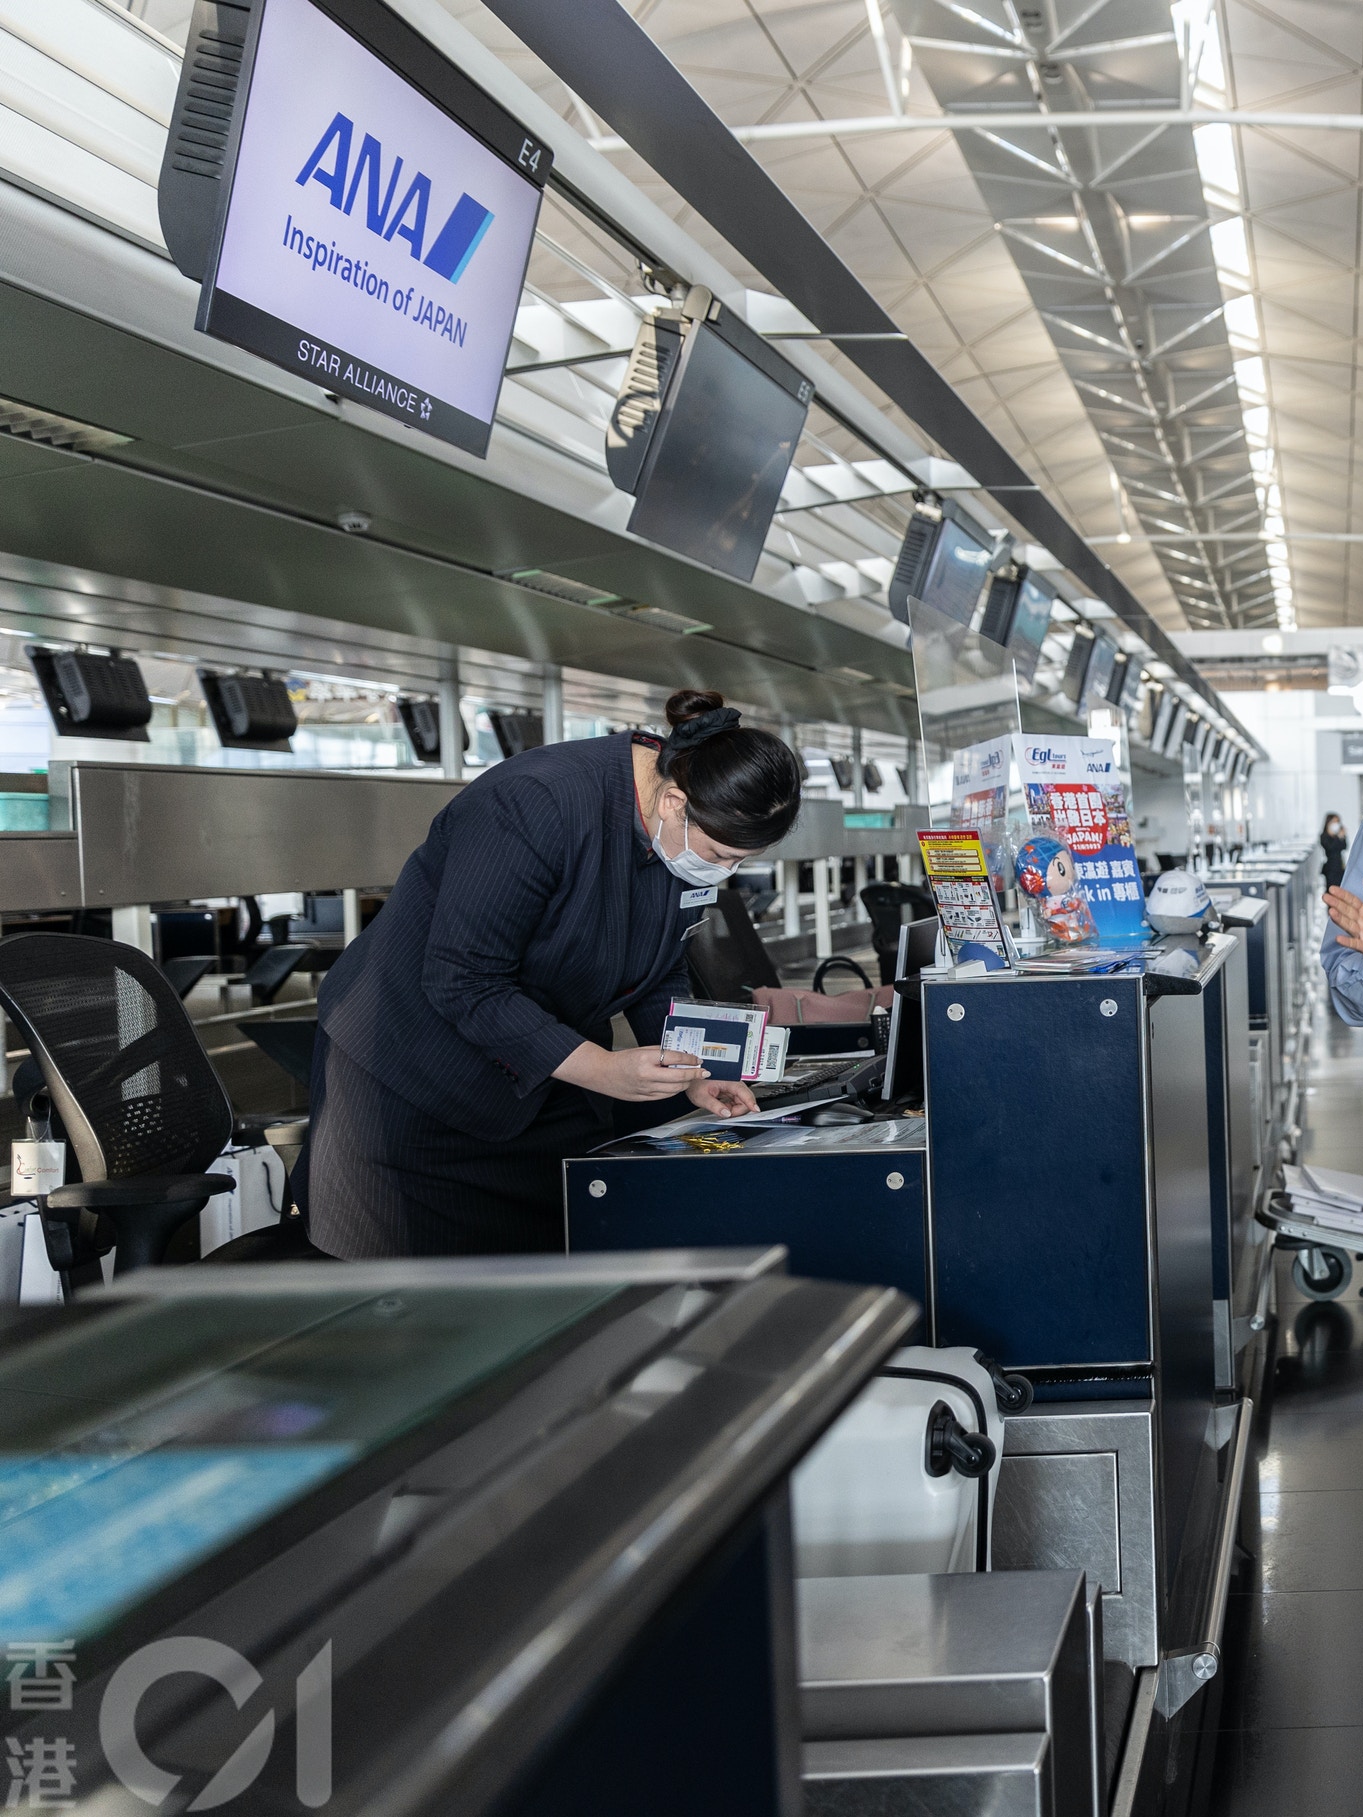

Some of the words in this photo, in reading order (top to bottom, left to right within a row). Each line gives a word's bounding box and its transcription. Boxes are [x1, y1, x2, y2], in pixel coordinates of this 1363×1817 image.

[518, 138, 541, 172] E4
[295, 112, 431, 261] ANA
[283, 215, 389, 304] Inspiration
[393, 288, 414, 315] of
[413, 296, 467, 348] JAPAN
[298, 340, 340, 377] STAR
[343, 364, 417, 412] ALLIANCE
[1087, 763, 1104, 772] ANA
[1066, 832, 1103, 844] JAPAN!
[1096, 884, 1112, 902] in
